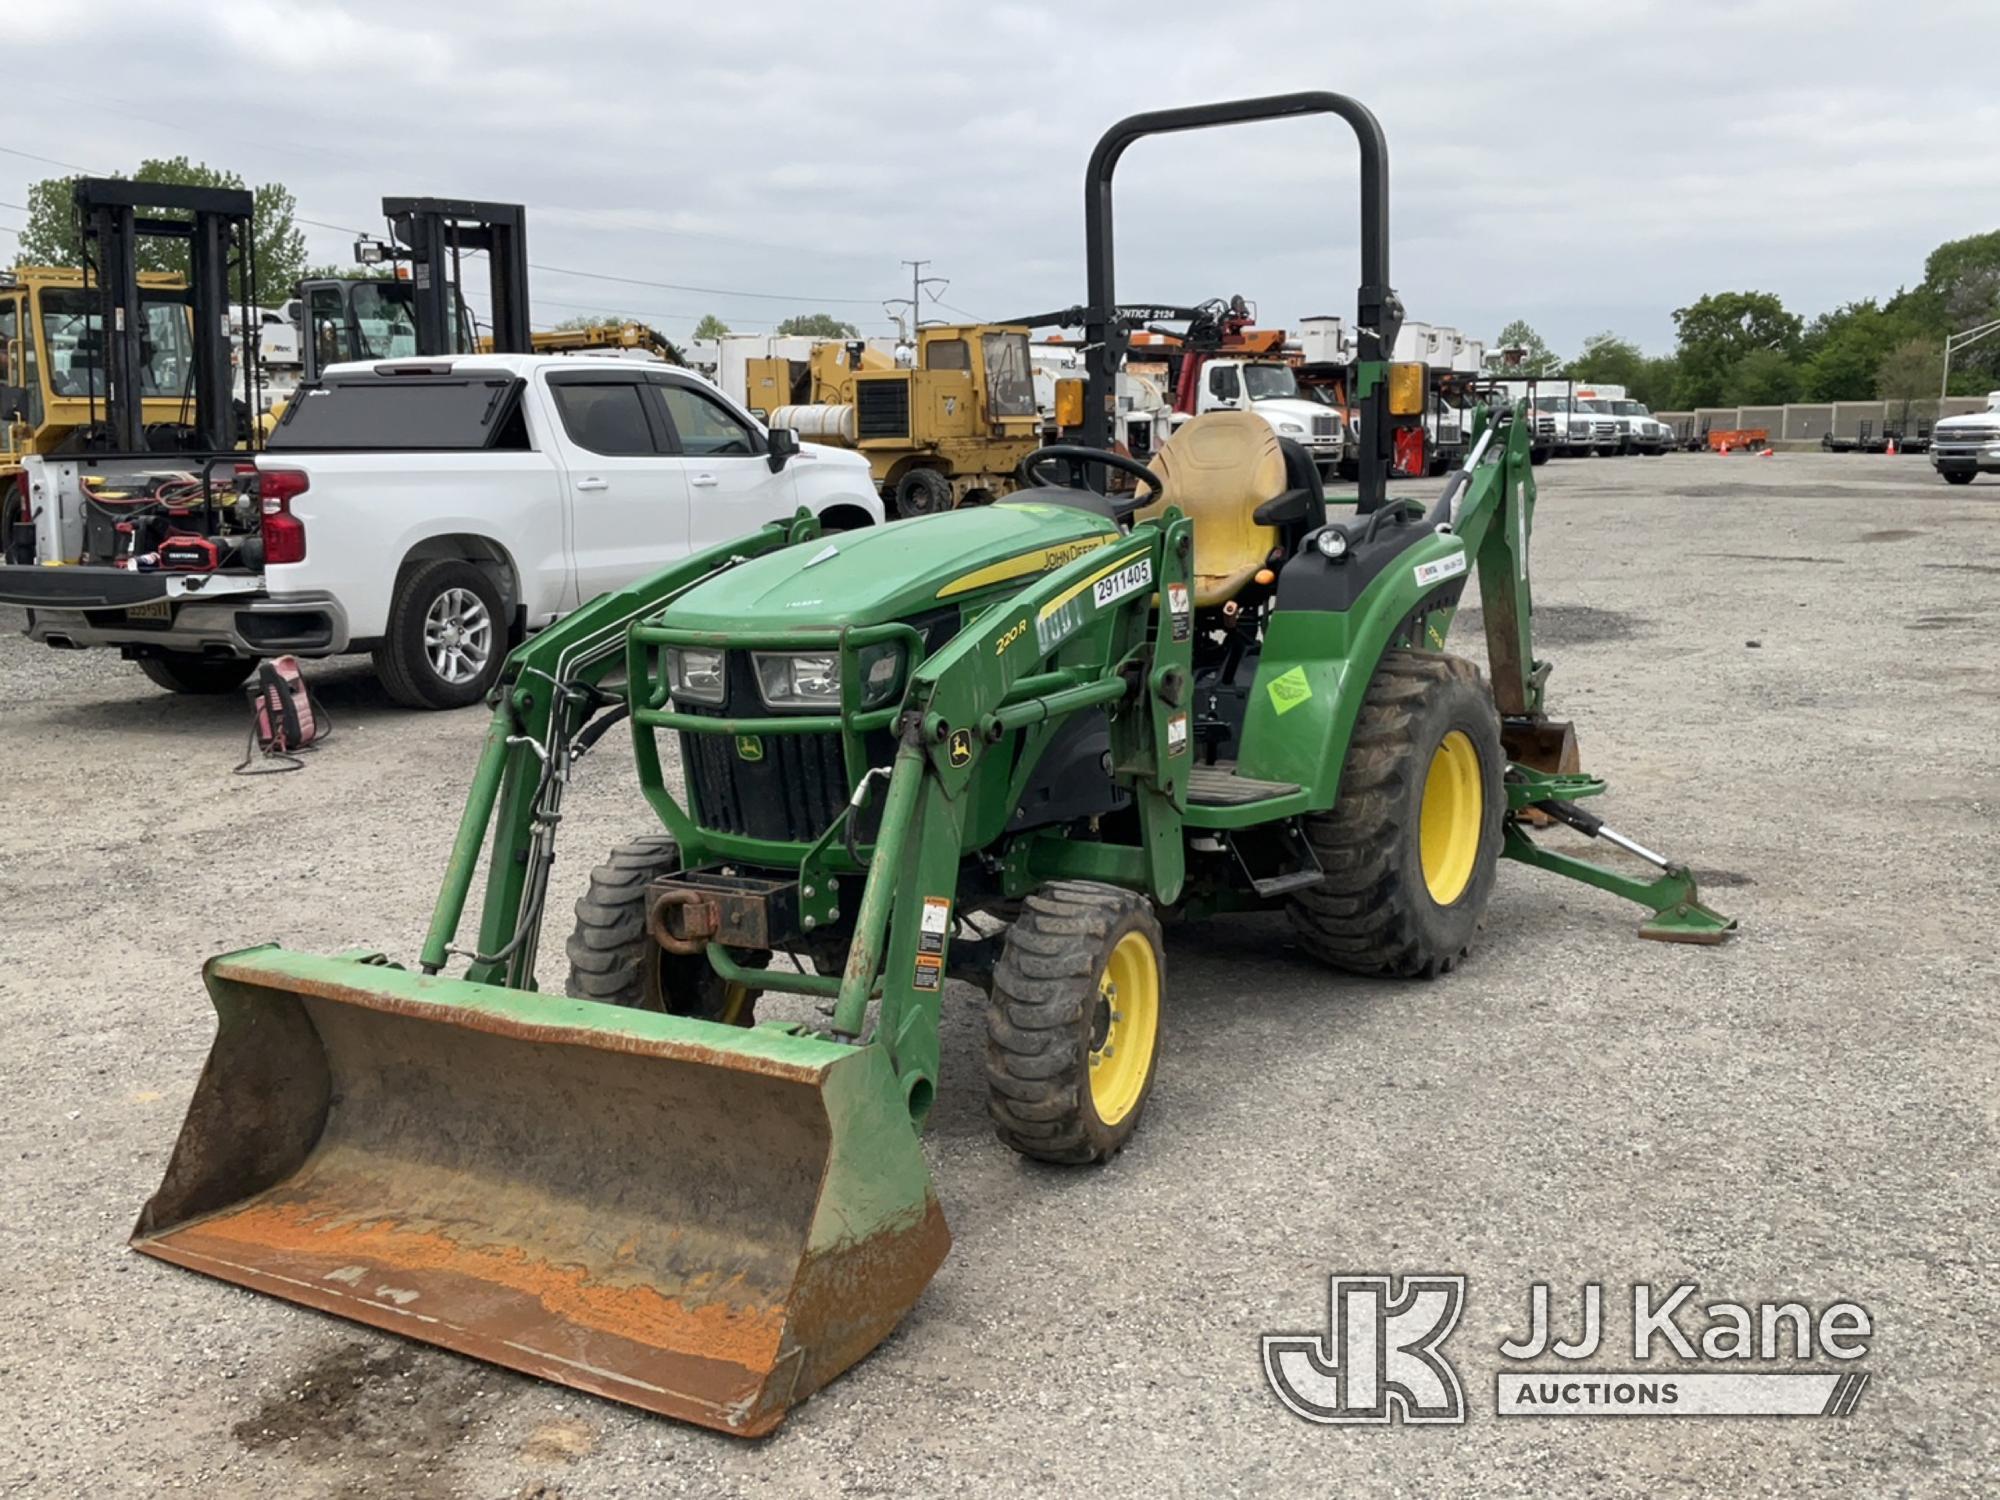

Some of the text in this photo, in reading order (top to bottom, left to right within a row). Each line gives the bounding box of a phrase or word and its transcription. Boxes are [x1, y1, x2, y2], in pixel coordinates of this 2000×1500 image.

[1121, 308, 1175, 319] NTICE 2124
[1043, 549, 1070, 569] JOHN
[1098, 561, 1149, 601] 2911405
[995, 626, 1018, 655] 220
[1018, 619, 1027, 635] R
